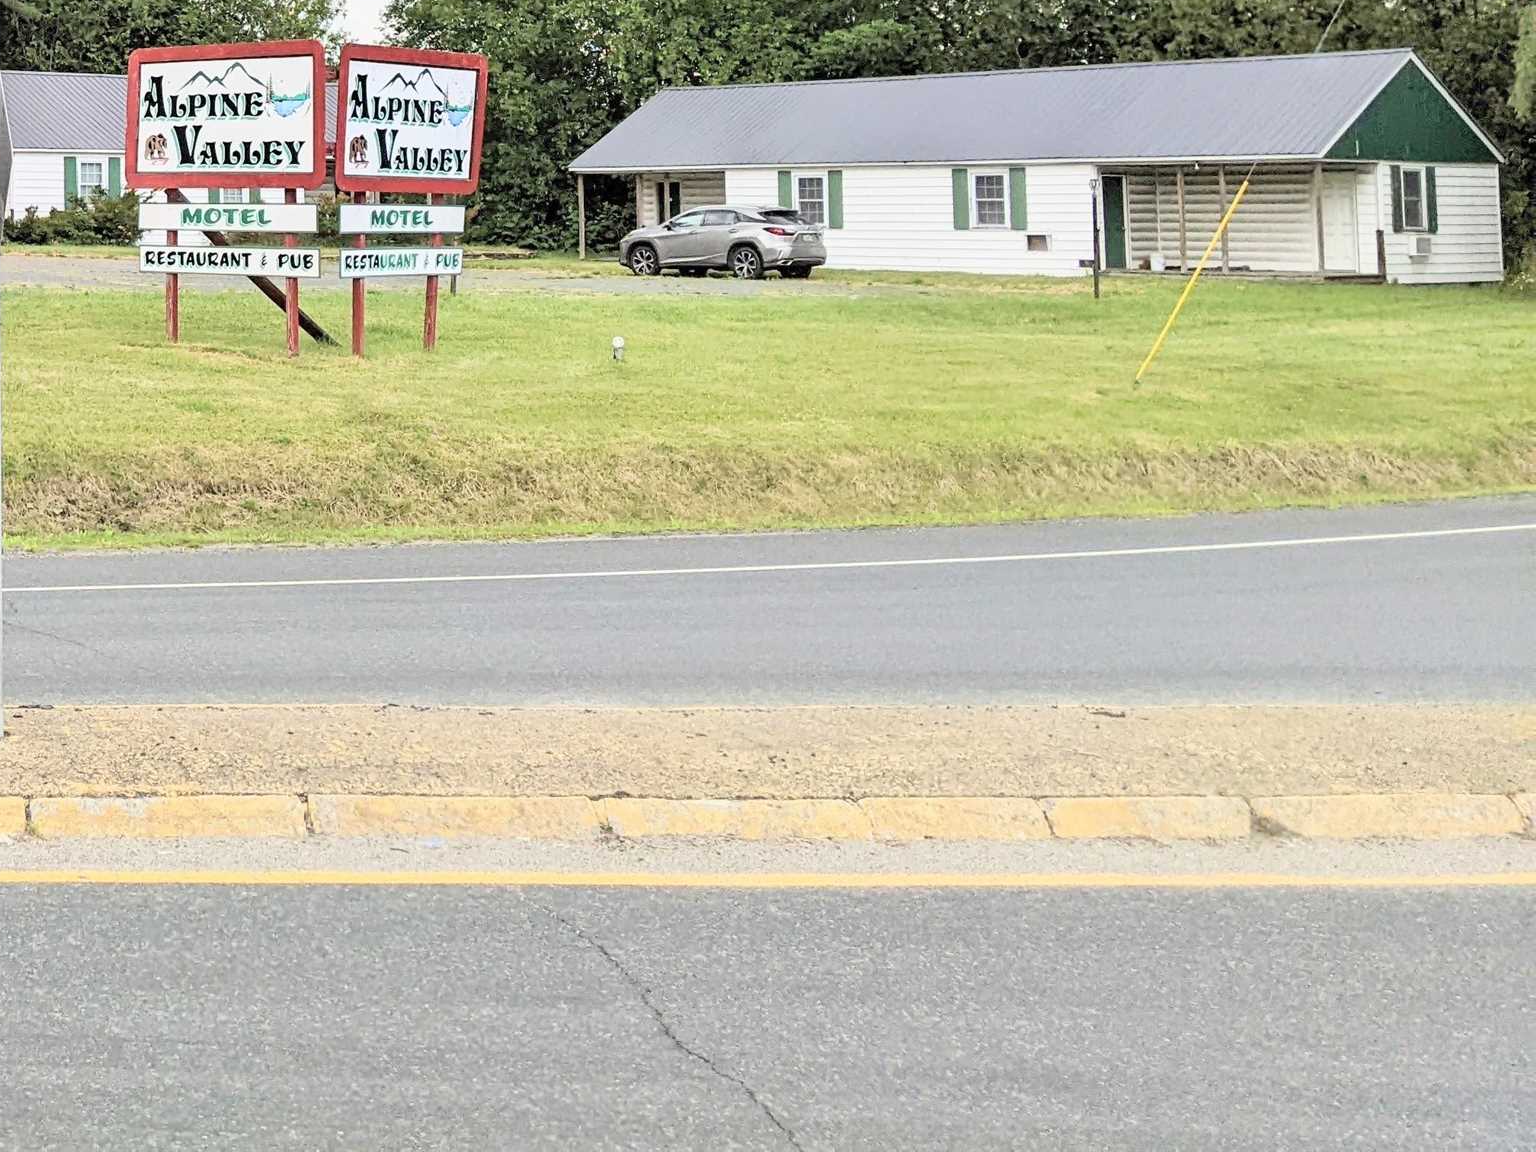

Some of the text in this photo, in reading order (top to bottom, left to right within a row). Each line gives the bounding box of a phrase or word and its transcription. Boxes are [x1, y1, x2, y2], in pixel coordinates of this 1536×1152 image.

[144, 76, 264, 119] ALPINE
[350, 74, 443, 124] ALPINE
[173, 125, 306, 166] VALLEY
[376, 129, 468, 173] VALLEY
[182, 208, 272, 225] MOTEL
[371, 209, 434, 226] MOTEL
[145, 251, 252, 268] RESTAURANT
[278, 254, 314, 269] PUB
[345, 254, 418, 269] RESTAURANT
[436, 254, 460, 268] PUB
